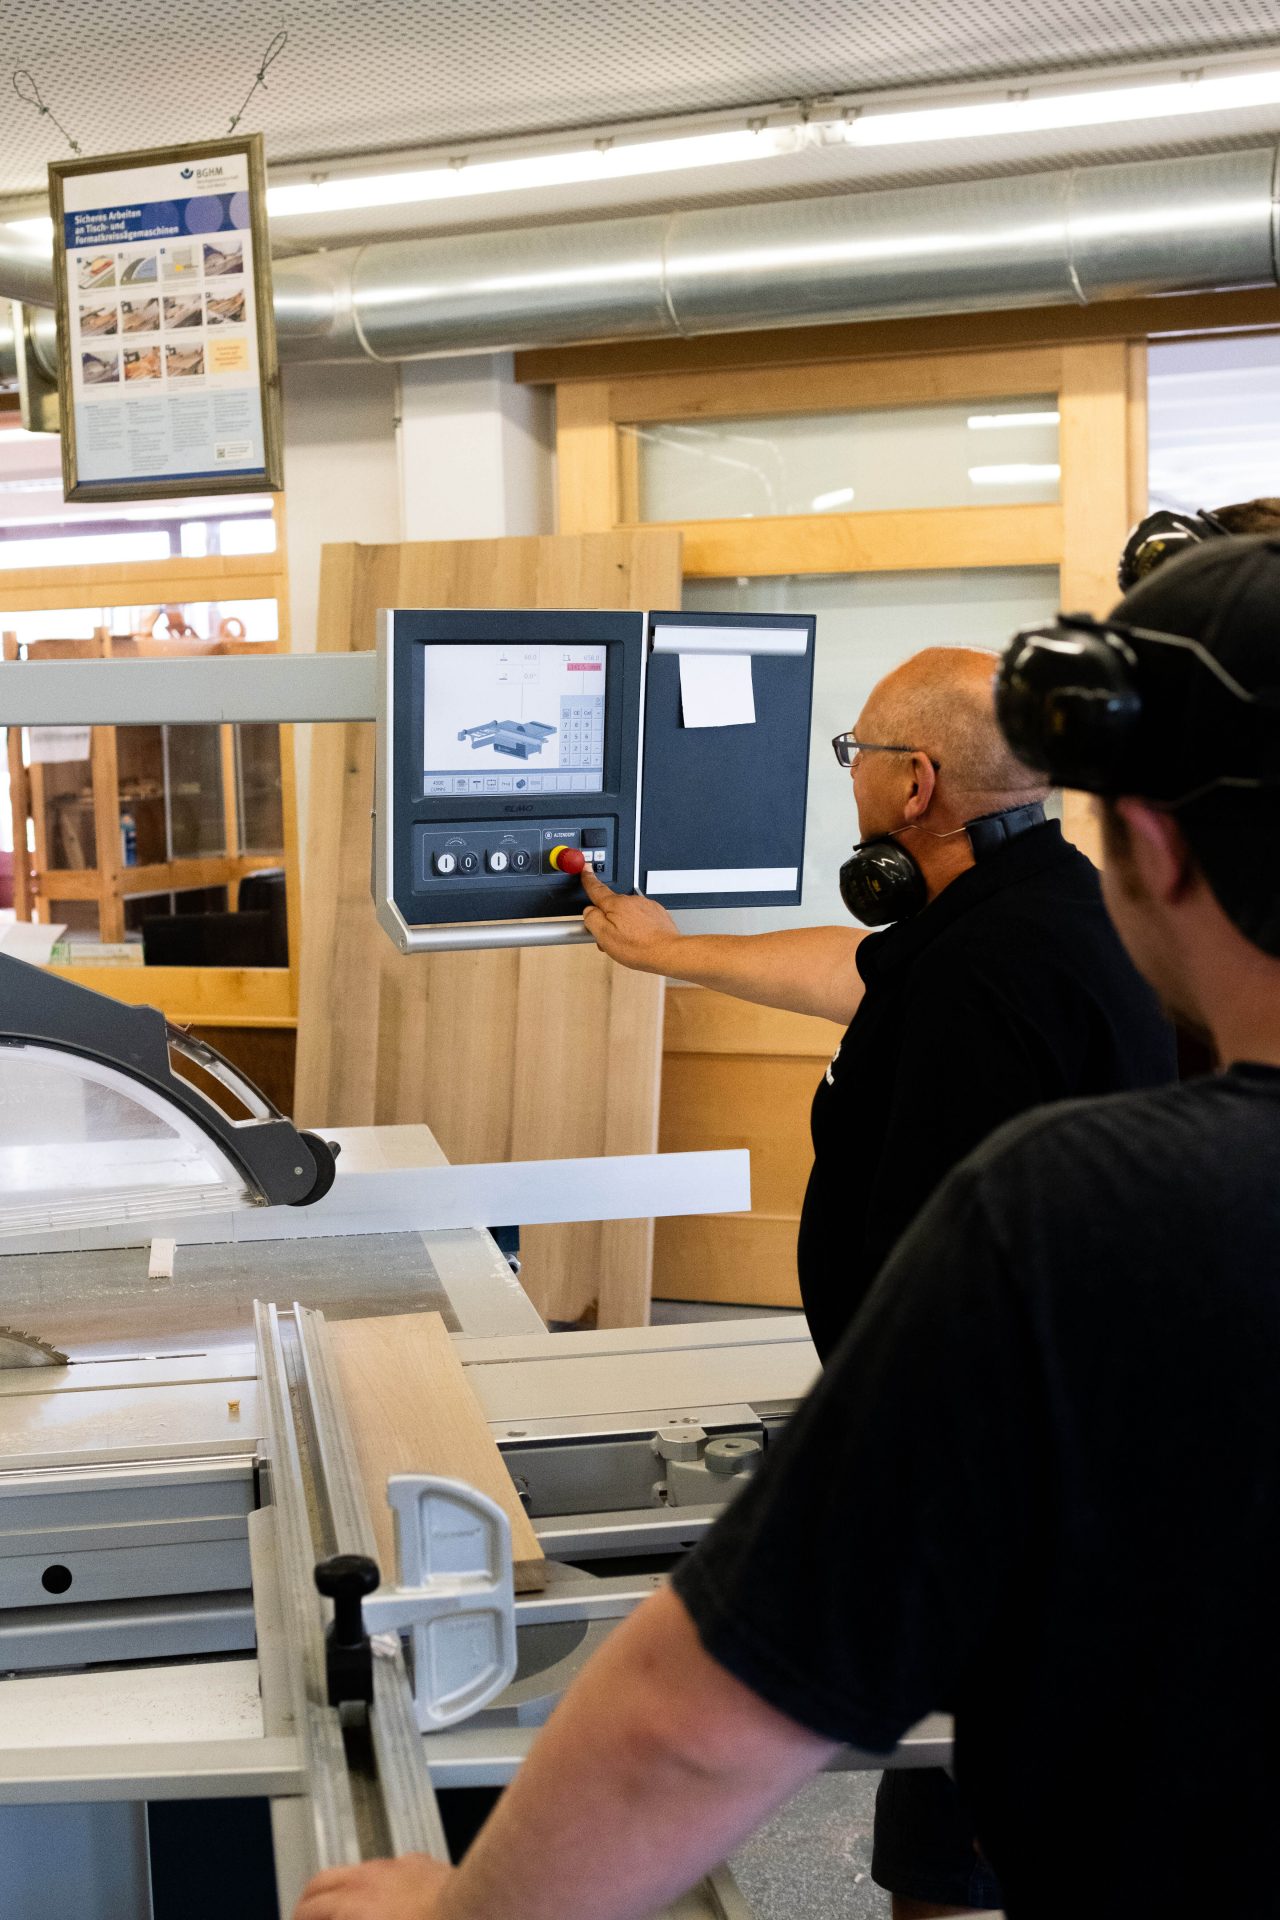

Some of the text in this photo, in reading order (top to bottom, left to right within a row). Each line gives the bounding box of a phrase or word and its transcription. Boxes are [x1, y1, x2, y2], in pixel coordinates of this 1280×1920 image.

[196, 166, 223, 178] BGHM
[74, 209, 142, 225] Sicheres Arbeiten
[74, 227, 85, 235] an
[110, 220, 125, 230] und
[504, 804, 534, 813] ELMO
